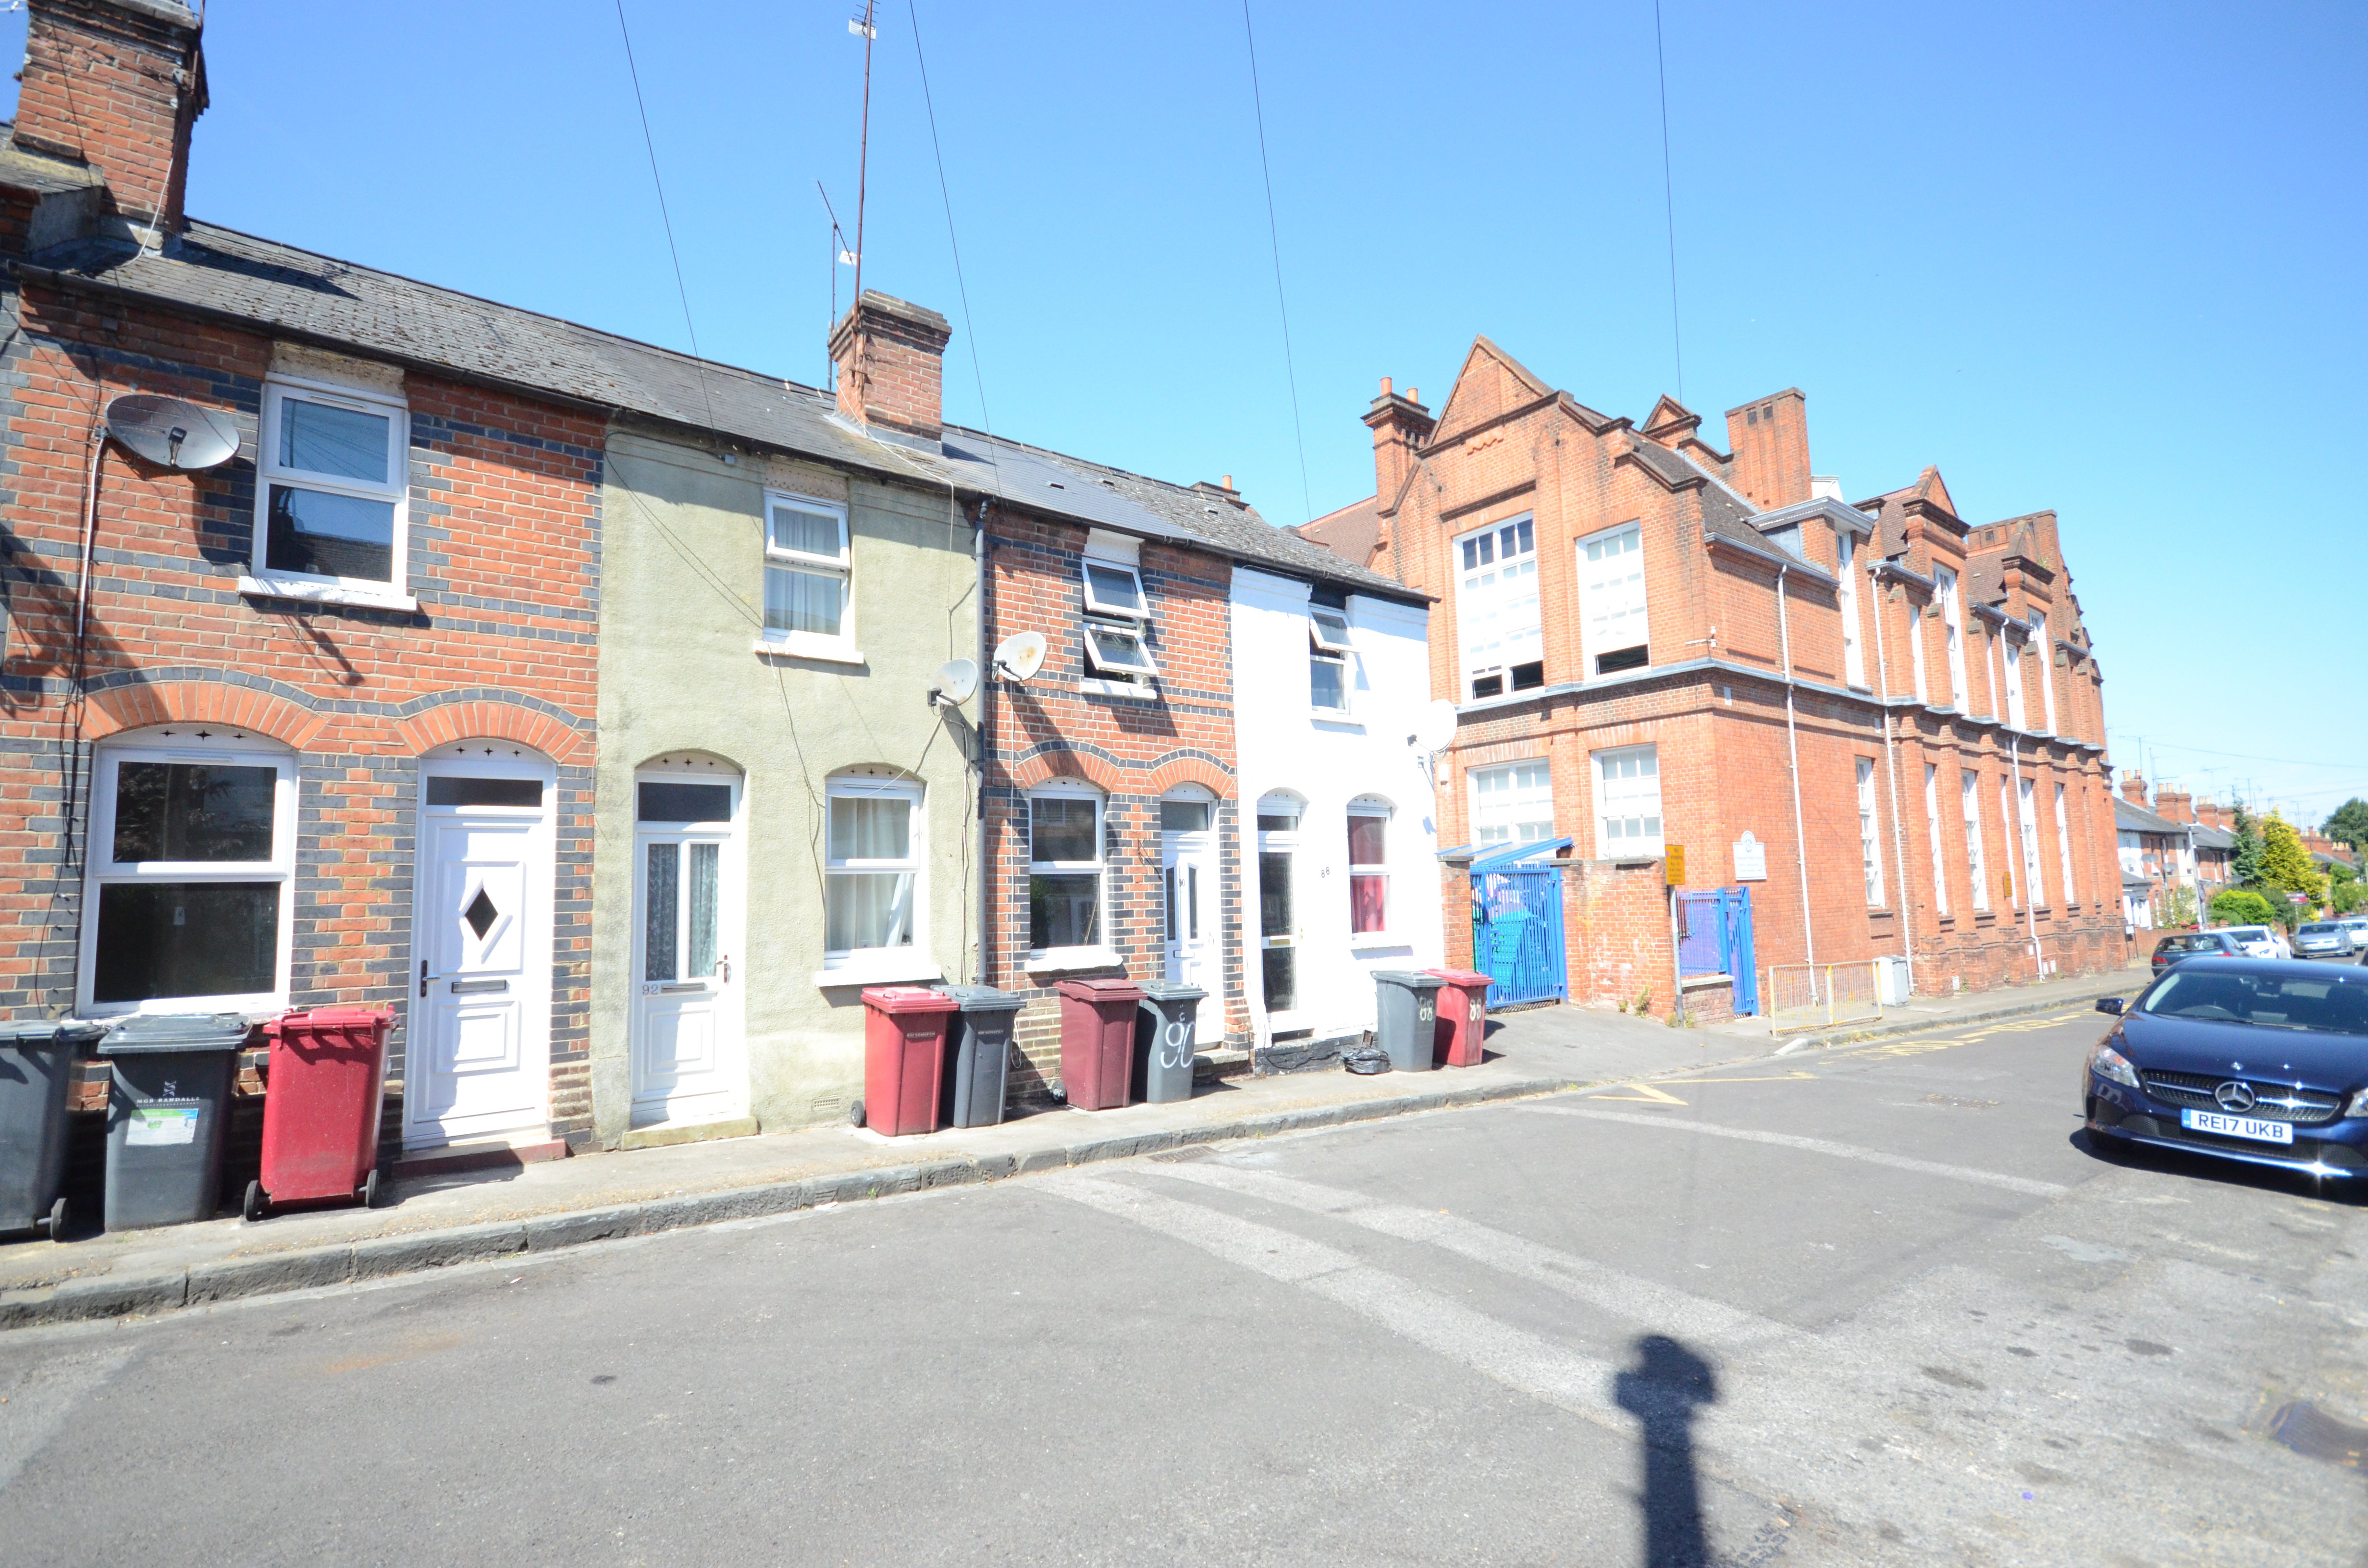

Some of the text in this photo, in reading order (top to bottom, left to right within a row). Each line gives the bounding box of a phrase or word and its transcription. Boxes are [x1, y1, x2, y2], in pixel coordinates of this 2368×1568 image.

[1179, 878, 1185, 887] 90
[1321, 866, 1330, 878] 88
[642, 984, 658, 995] 92
[1419, 996, 1433, 1021] 88
[1469, 997, 1482, 1021] 88
[1160, 1021, 1196, 1068] 90
[2198, 1114, 2283, 1139] RE17 UKB
